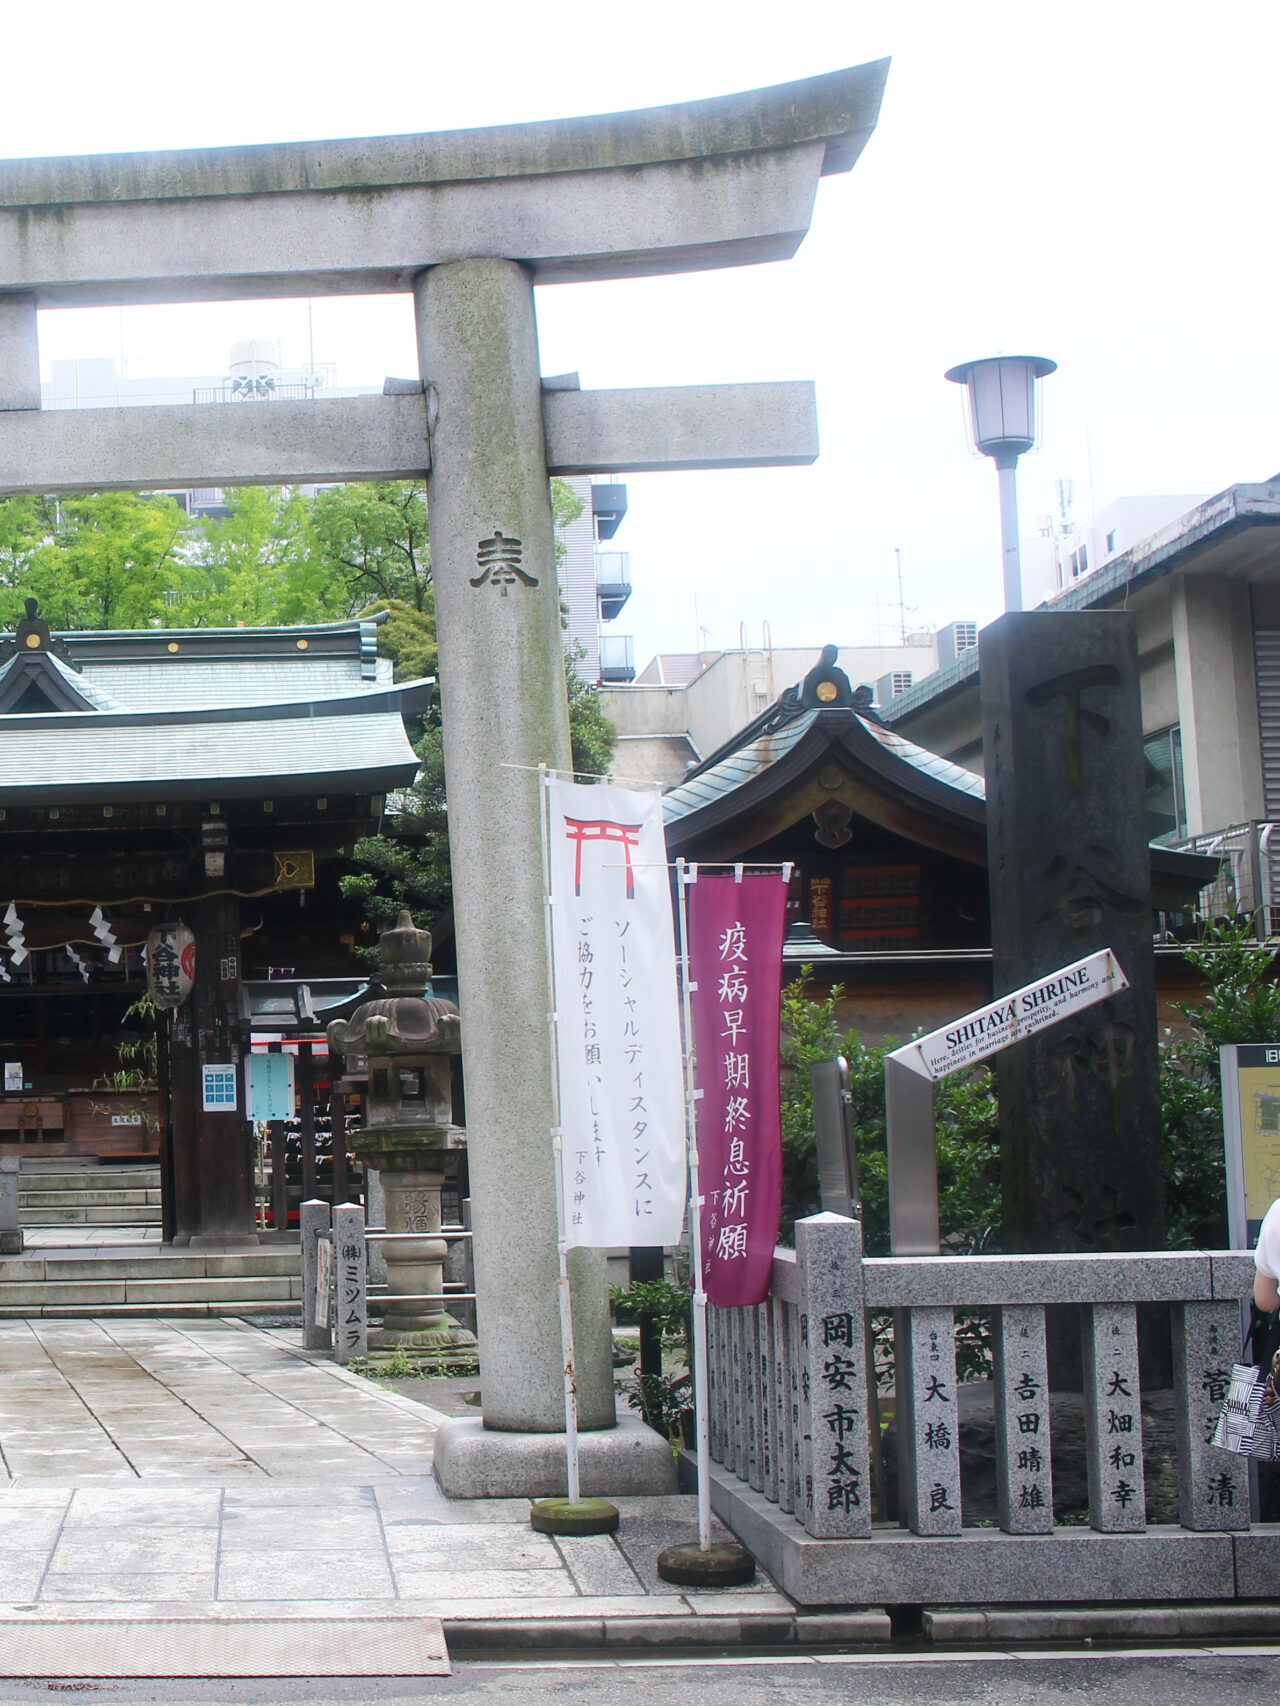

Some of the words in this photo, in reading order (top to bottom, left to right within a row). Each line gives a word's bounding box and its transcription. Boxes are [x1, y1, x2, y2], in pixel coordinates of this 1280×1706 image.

[152, 927, 180, 996] 下谷神社
[930, 1054, 949, 1066] Here,
[951, 1042, 973, 1056] deities
[975, 1036, 985, 1047] for
[987, 1022, 1015, 1043] business
[1017, 1004, 1052, 1027] prosperity,
[1053, 996, 1067, 1007] and
[1069, 980, 1099, 998] harmony
[1102, 972, 1116, 983] and
[945, 1002, 1016, 1049] SHITAYA
[1022, 967, 1090, 1012] SHRINE
[578, 917, 606, 1167] ご協力をお願いします
[614, 920, 653, 1216] ソーシャルディスタンスに
[716, 921, 751, 1260] 疫病早期終息祈願
[934, 1056, 967, 1074] happiness
[969, 1049, 976, 1058] in
[978, 1034, 1010, 1053] marriage
[1011, 1027, 1022, 1038] are
[1024, 1010, 1059, 1031] enshrined.
[572, 1150, 588, 1226] 下谷神社
[821, 1313, 862, 1514] 岡安市太郎
[924, 1374, 955, 1513] 大橋良
[1106, 1371, 1136, 1509] 大畑和幸
